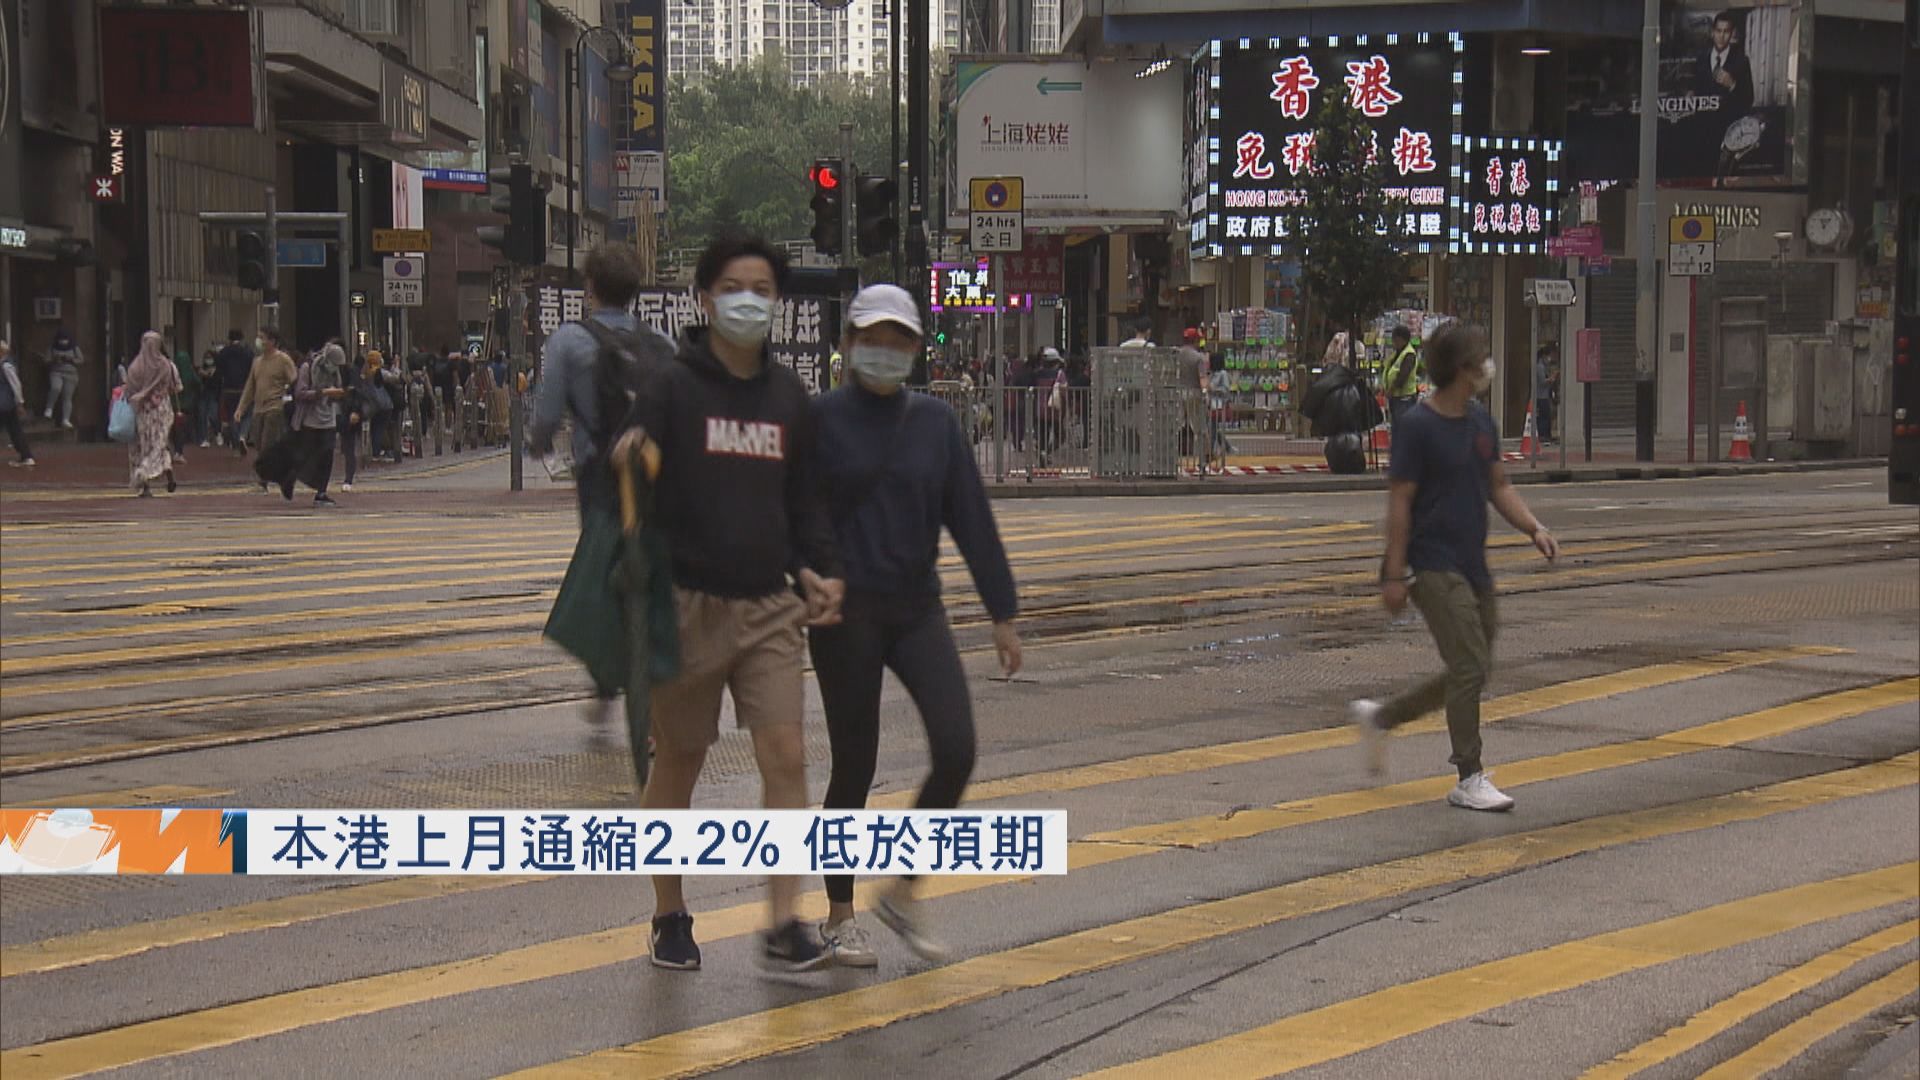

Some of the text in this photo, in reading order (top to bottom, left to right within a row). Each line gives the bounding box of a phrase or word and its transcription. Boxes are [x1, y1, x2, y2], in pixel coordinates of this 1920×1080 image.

[631, 16, 655, 132] IKEA
[1270, 54, 1404, 120] 香港
[1632, 95, 1720, 114] LNGINES
[1486, 156, 1530, 196] 香港
[1225, 189, 1266, 207] HONG
[976, 215, 1016, 228] 24 hrs
[981, 232, 1012, 248] 全日
[1697, 244, 1705, 255] 7
[1698, 262, 1711, 273] 12
[387, 281, 418, 291] 24 hrs
[391, 292, 415, 303] 全日
[705, 417, 783, 458] MARVEL
